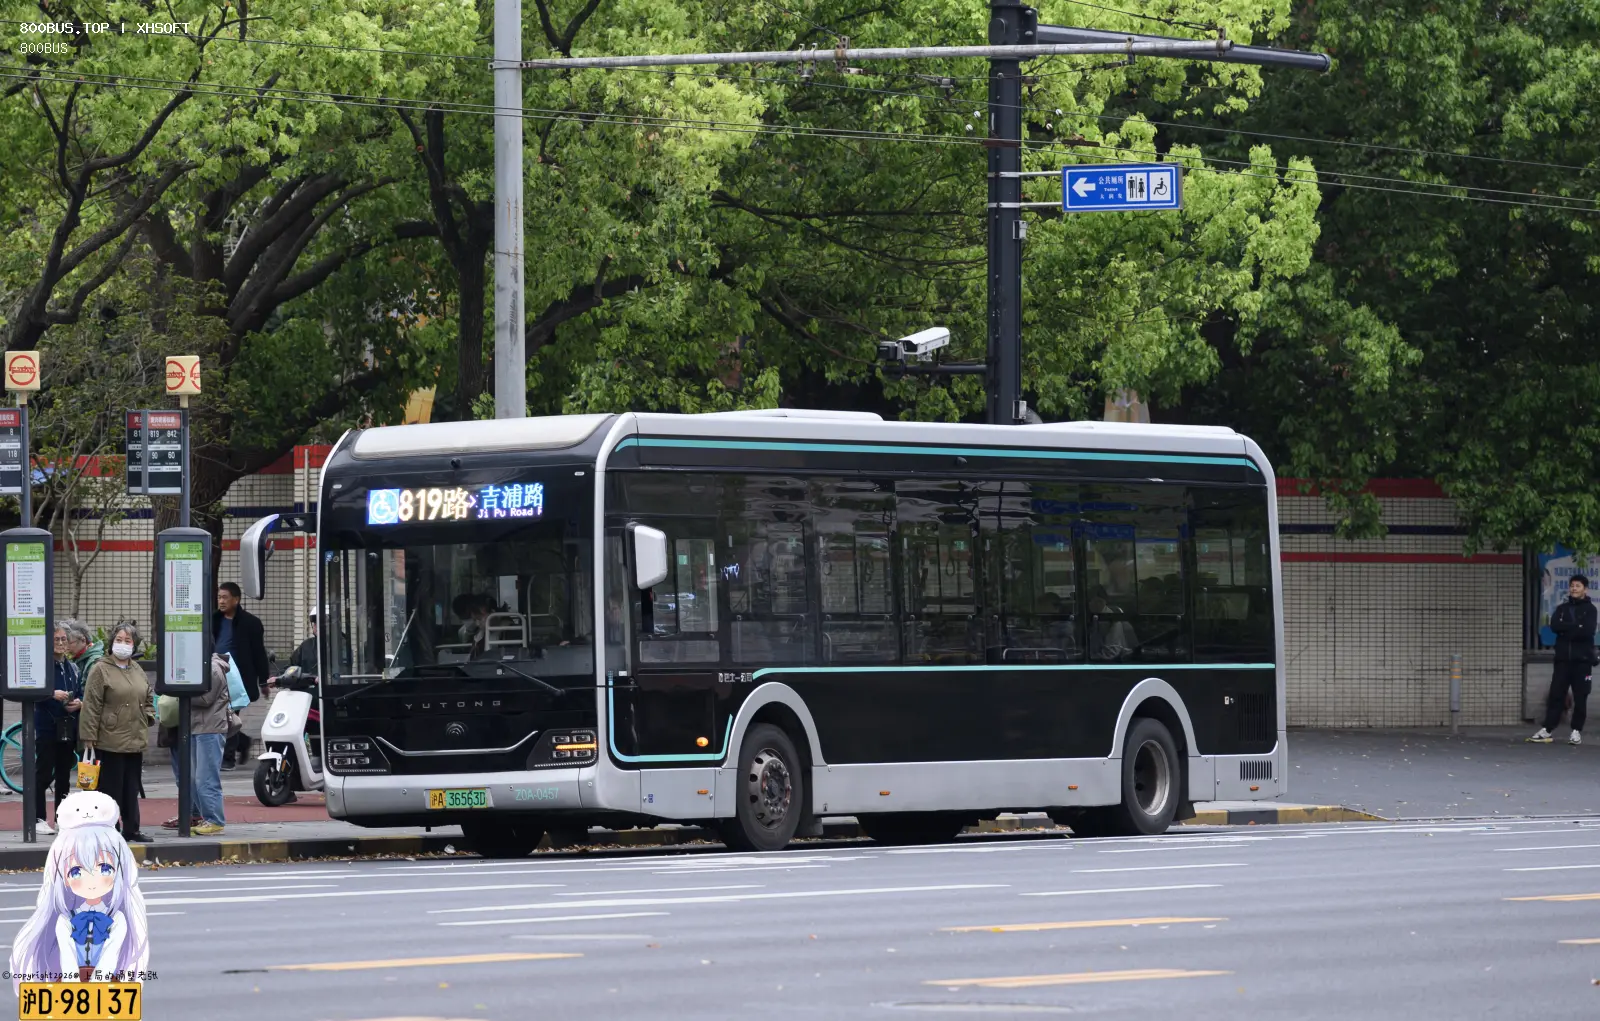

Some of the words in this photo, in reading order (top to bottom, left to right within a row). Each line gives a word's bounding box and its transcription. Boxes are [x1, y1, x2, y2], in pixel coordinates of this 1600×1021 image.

[1098, 176, 1123, 185] 公共厕所
[149, 430, 160, 438] 819
[166, 429, 177, 438] 842
[7, 449, 18, 458] 118
[151, 451, 159, 460] 90
[167, 451, 176, 459] 60
[398, 487, 470, 521] 819路
[480, 483, 543, 509] 吉浦路
[477, 508, 489, 518] Ji
[510, 507, 533, 517] Road
[405, 701, 500, 709] YUTONG
